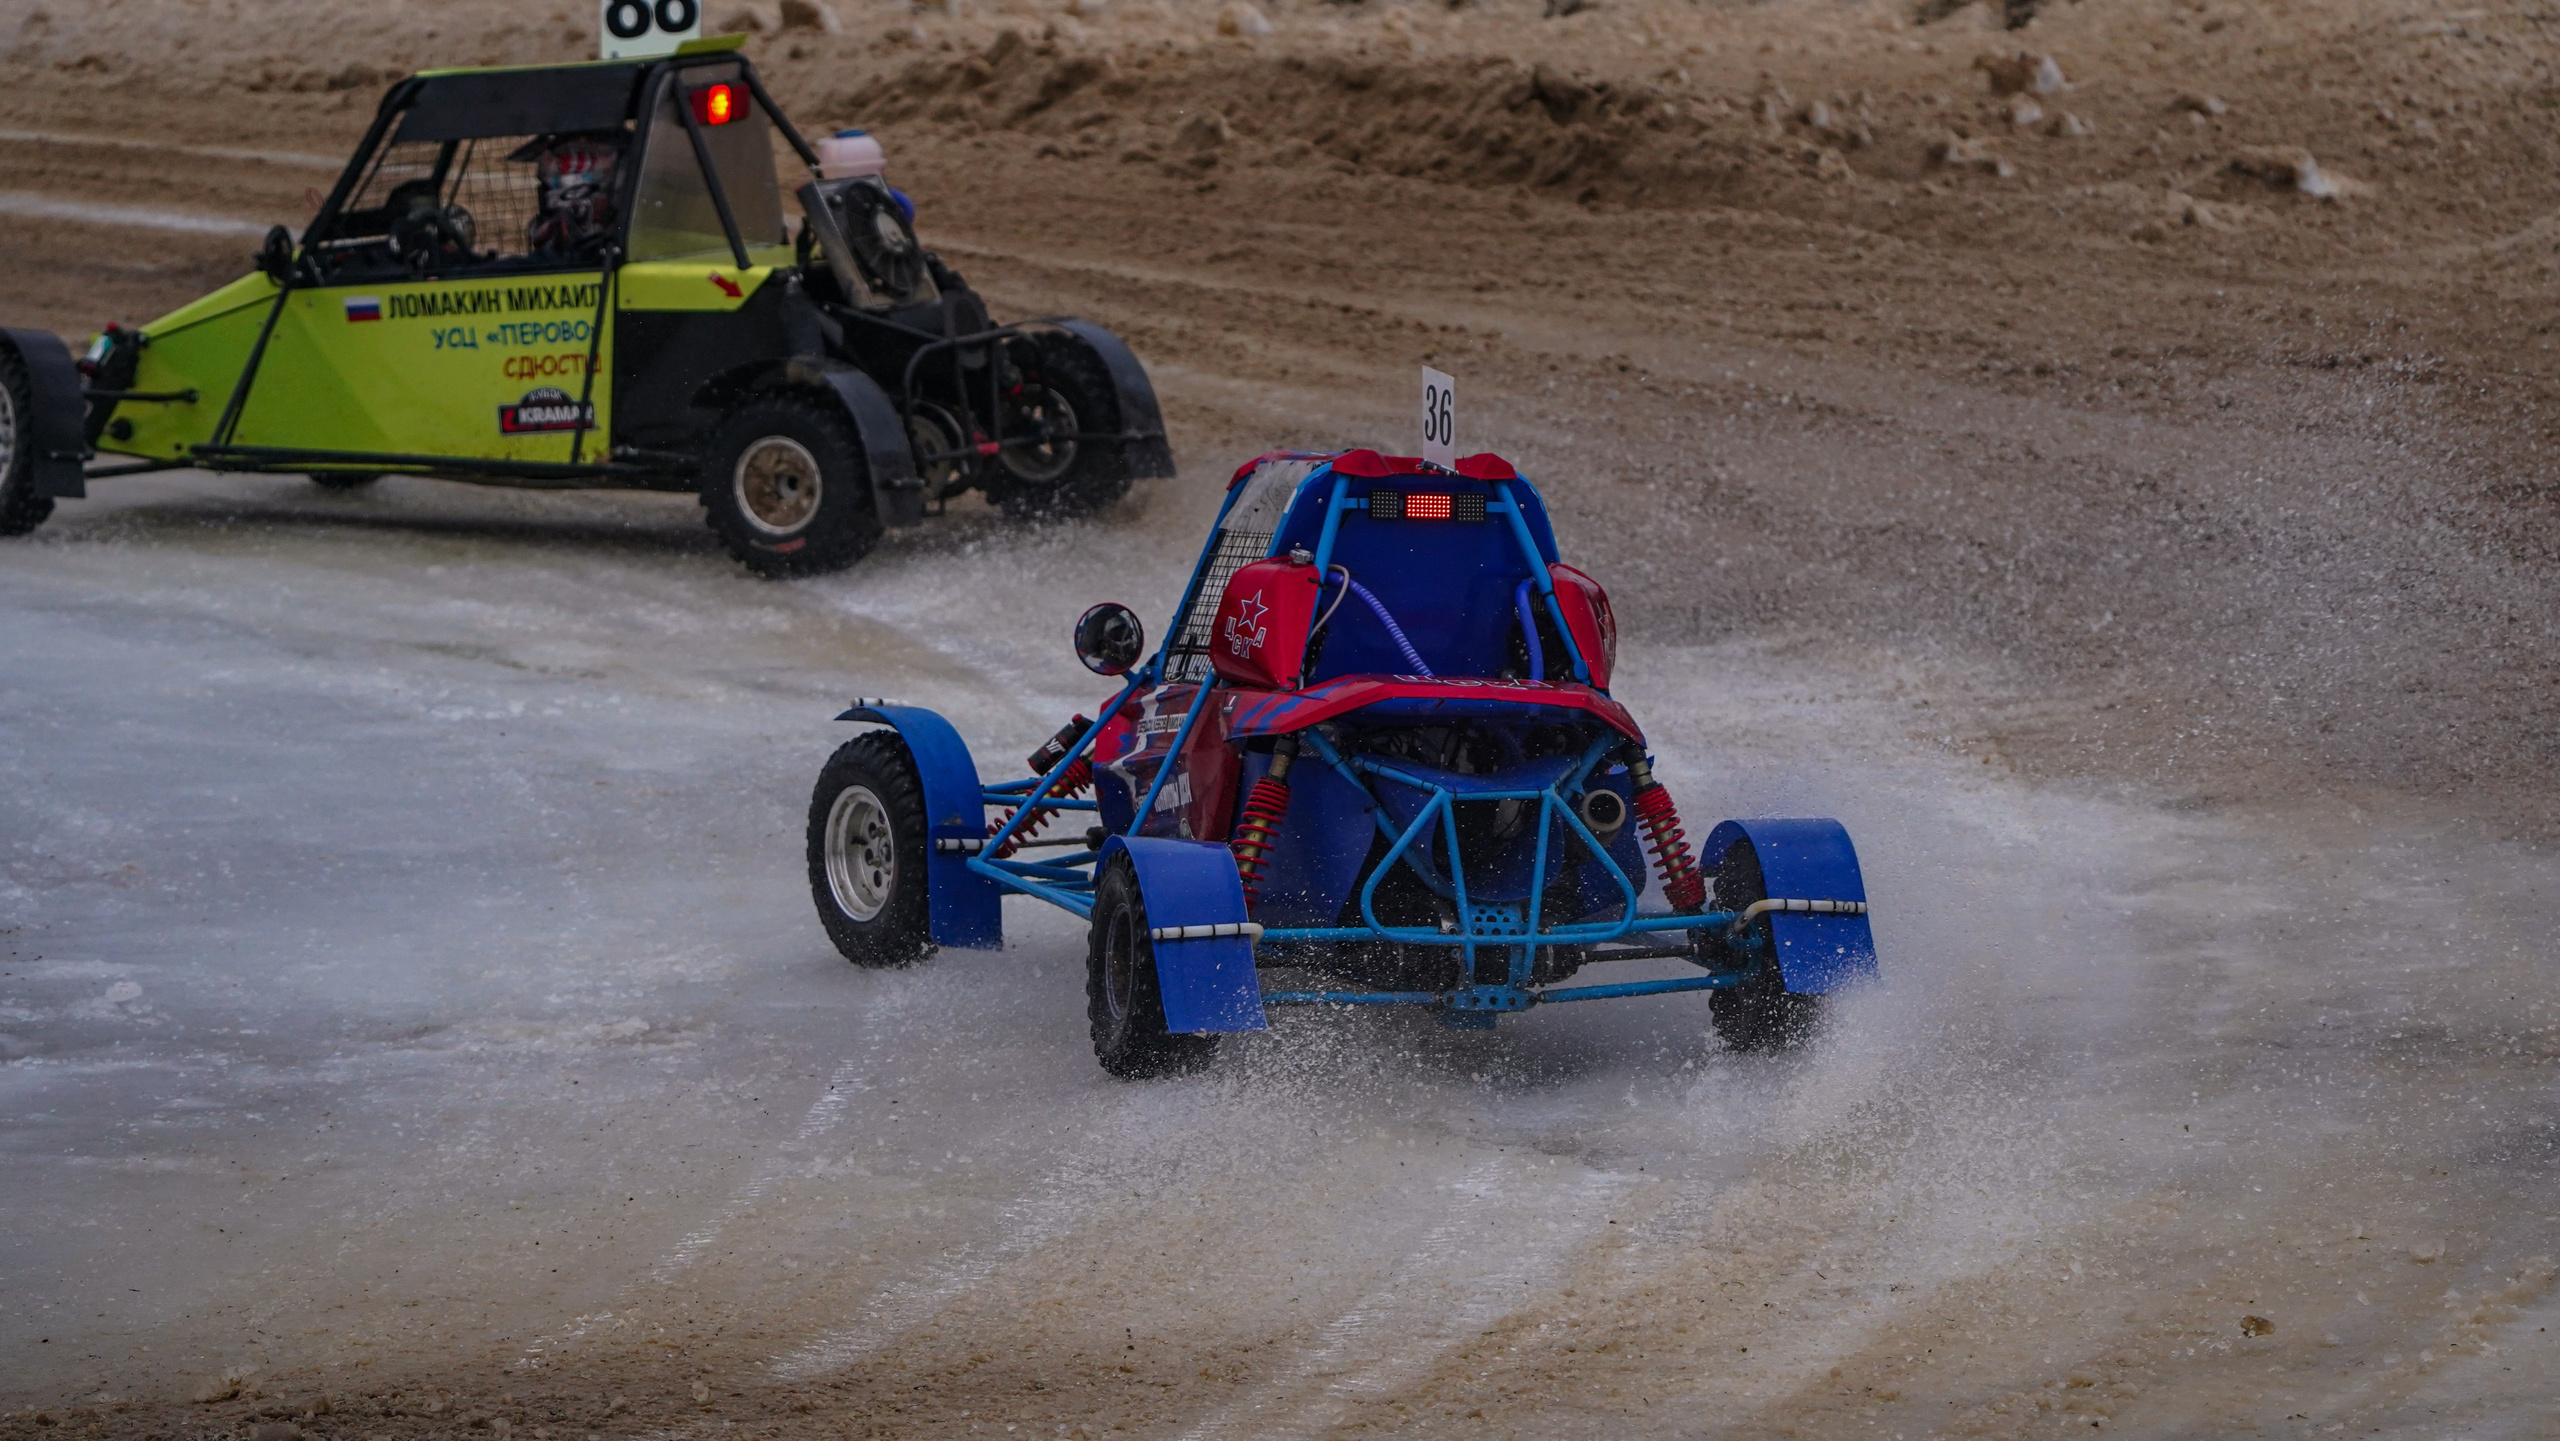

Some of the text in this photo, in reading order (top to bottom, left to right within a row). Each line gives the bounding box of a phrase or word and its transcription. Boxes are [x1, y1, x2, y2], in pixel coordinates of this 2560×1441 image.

[389, 289, 500, 318] ЛОМАКИН
[431, 326, 479, 350] УСЦ
[1425, 385, 1451, 446] 36
[1224, 616, 1267, 659] ЦСКА
